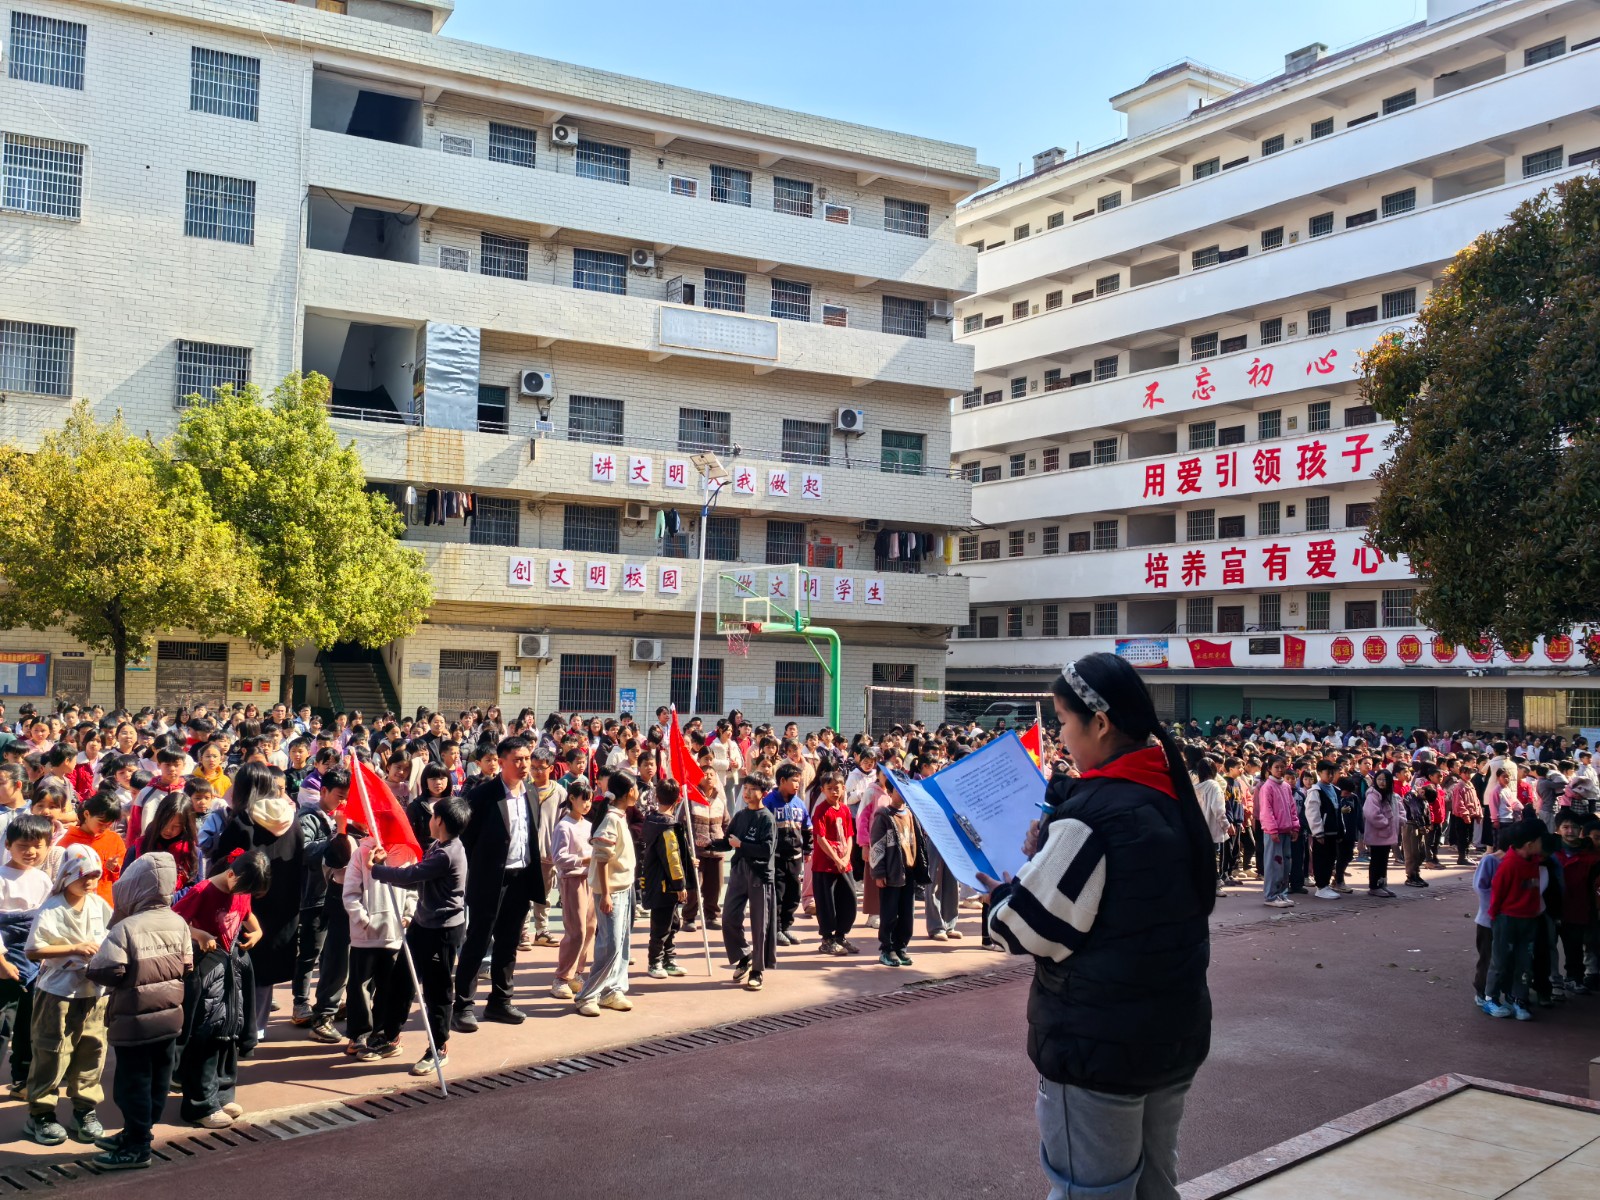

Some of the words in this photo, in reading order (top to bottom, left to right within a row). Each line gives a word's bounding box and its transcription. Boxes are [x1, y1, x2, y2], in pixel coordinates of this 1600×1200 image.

[1143, 348, 1338, 410] 不忘初心
[1143, 433, 1374, 498] 用爱引领孩子
[513, 560, 678, 590] 创文明校园
[736, 575, 882, 601] 做文明学生
[1145, 538, 1416, 588] 培养富有爱心
[1366, 643, 1383, 655] 民主
[1400, 642, 1418, 655] 文明
[1548, 642, 1569, 653] 公正
